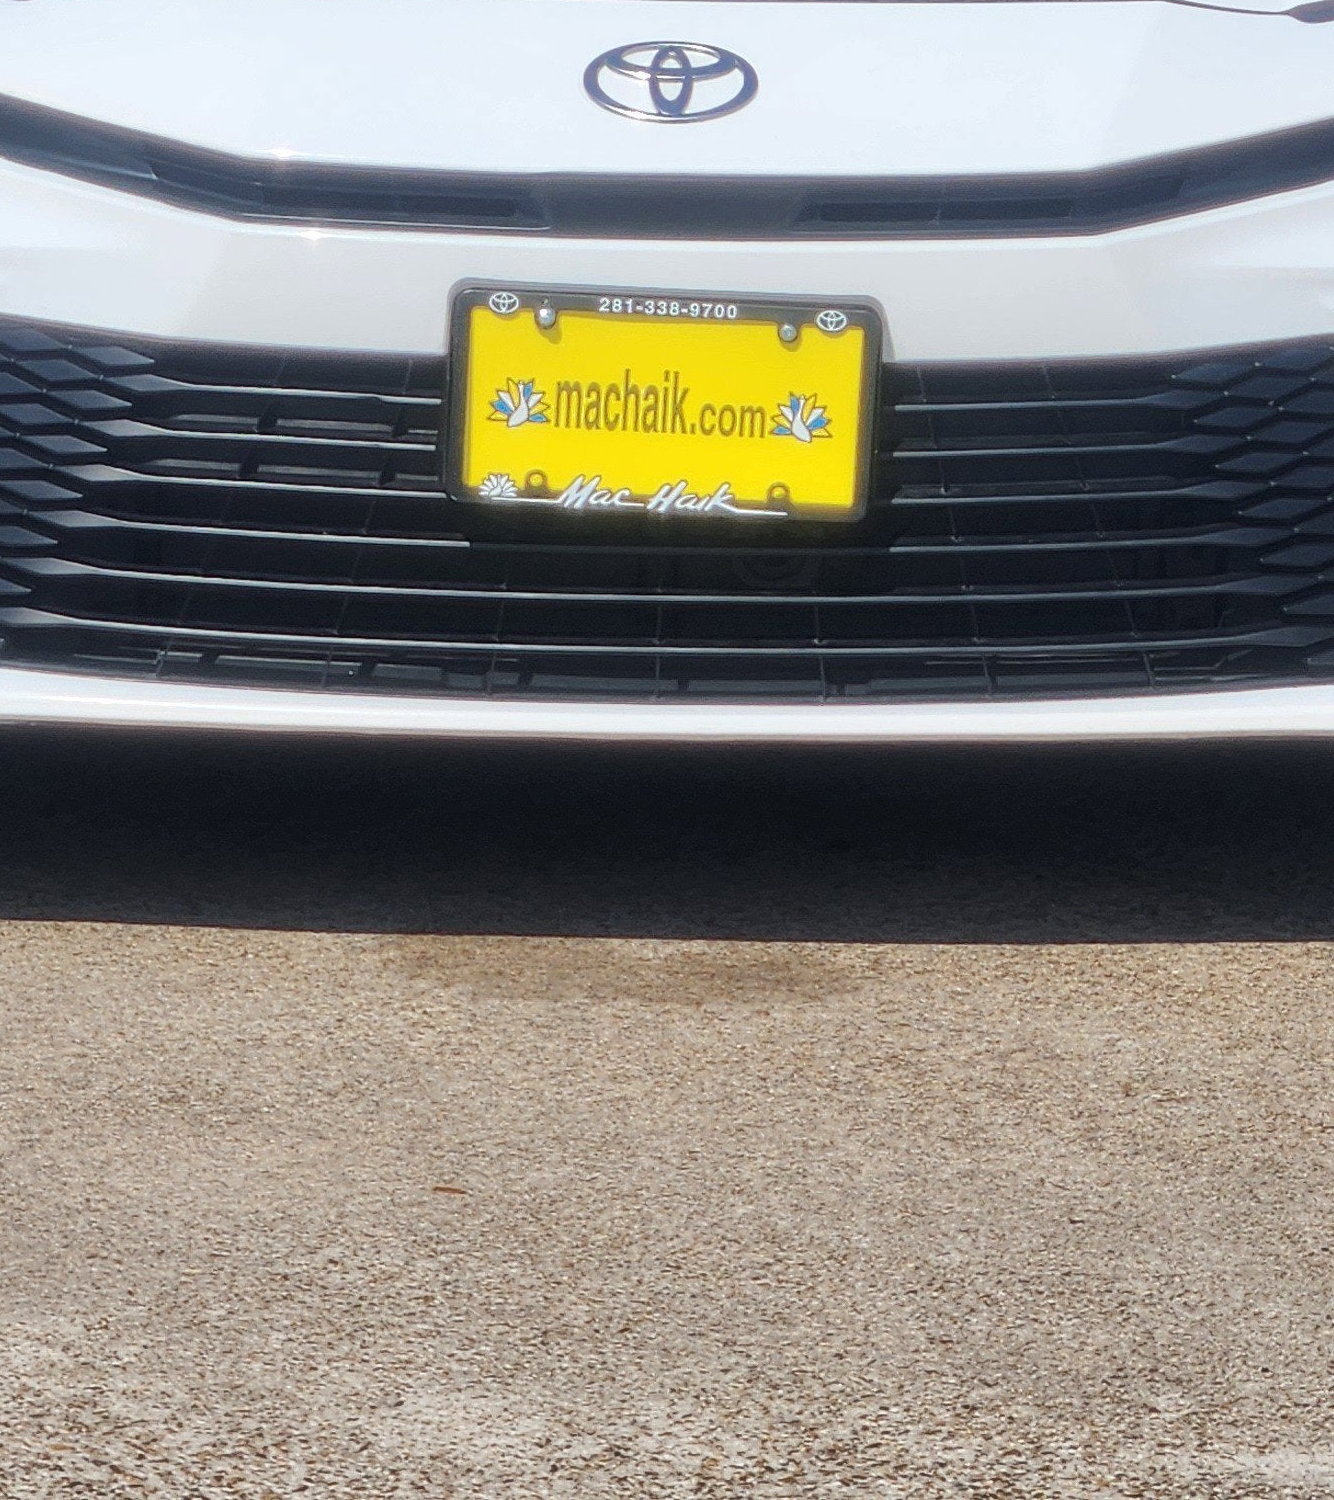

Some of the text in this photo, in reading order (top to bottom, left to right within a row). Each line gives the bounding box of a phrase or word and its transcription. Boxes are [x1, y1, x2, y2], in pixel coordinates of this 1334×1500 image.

[598, 297, 739, 320] 281-338-9700
[553, 368, 767, 439] machaik.com
[556, 474, 747, 515] Mac Haik
